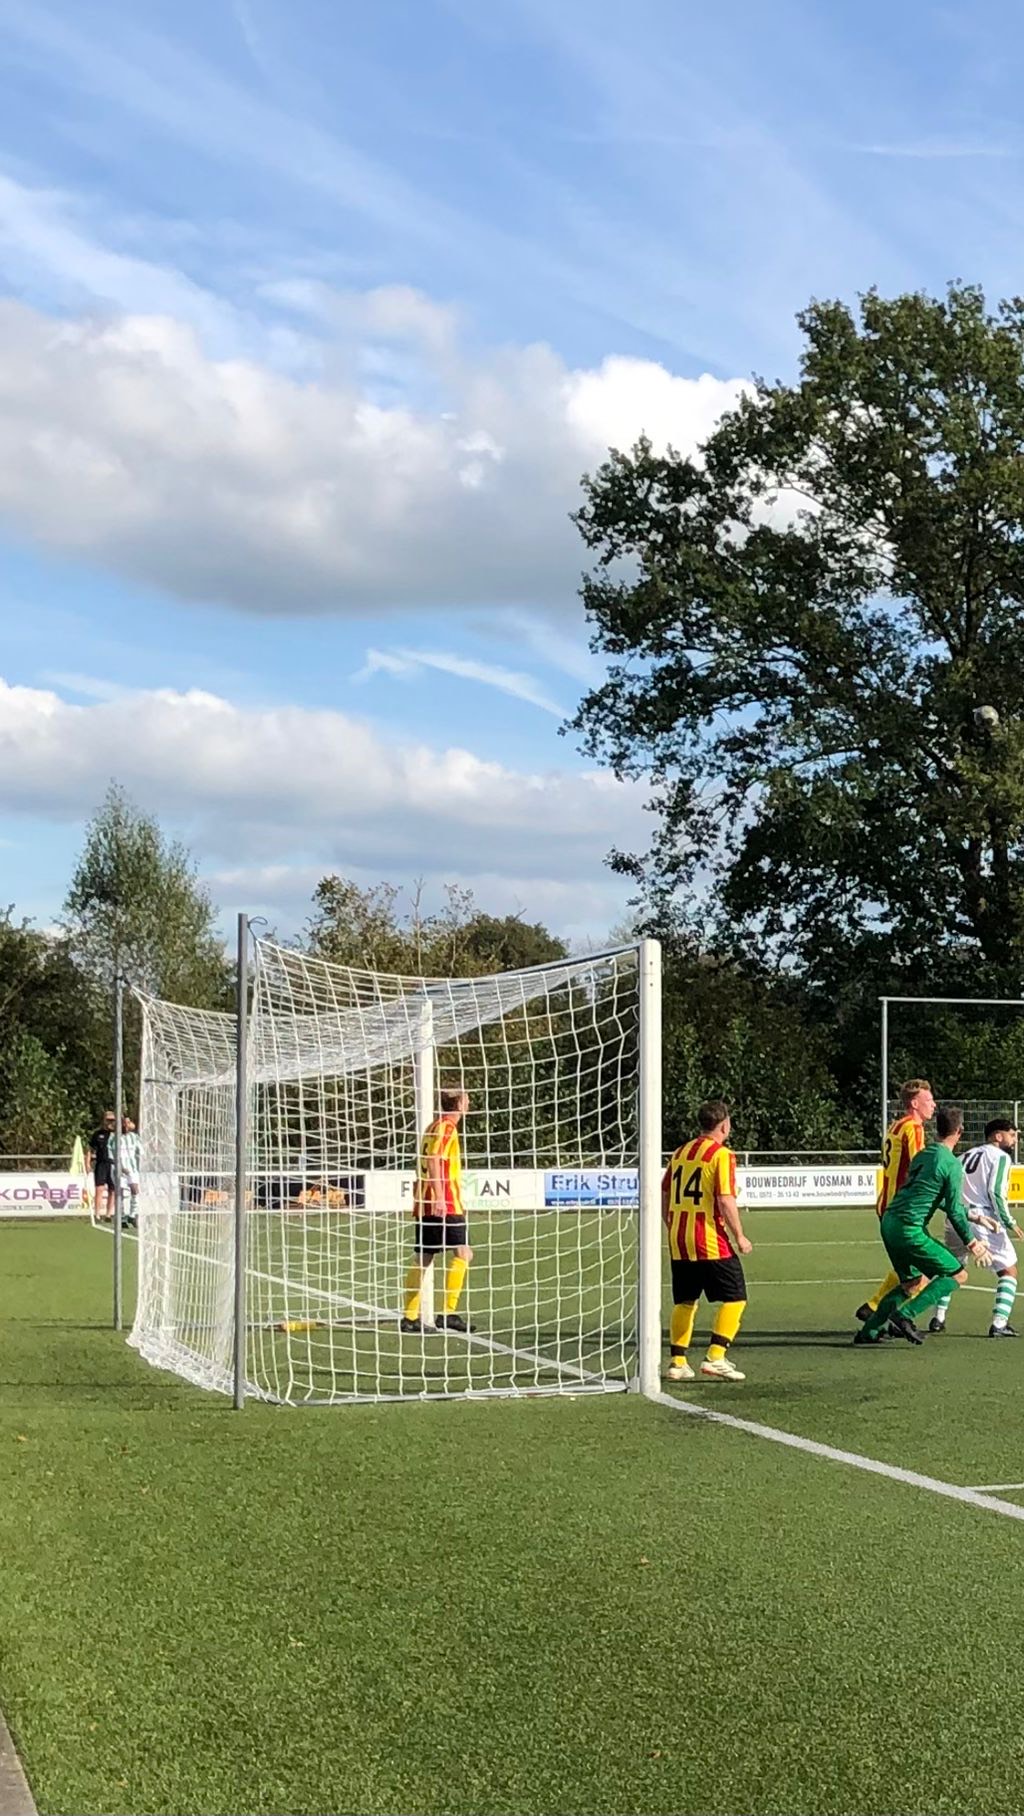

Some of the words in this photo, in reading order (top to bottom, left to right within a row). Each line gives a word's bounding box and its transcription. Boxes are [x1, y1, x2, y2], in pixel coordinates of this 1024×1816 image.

[962, 1151, 984, 1174] 10
[551, 1175, 590, 1191] Erik
[597, 1174, 638, 1190] Stru
[672, 1164, 703, 1206] 14
[745, 1176, 807, 1188] BOUWBEDRIJF
[813, 1175, 852, 1186] VOSMAN
[857, 1174, 875, 1186] B.V.
